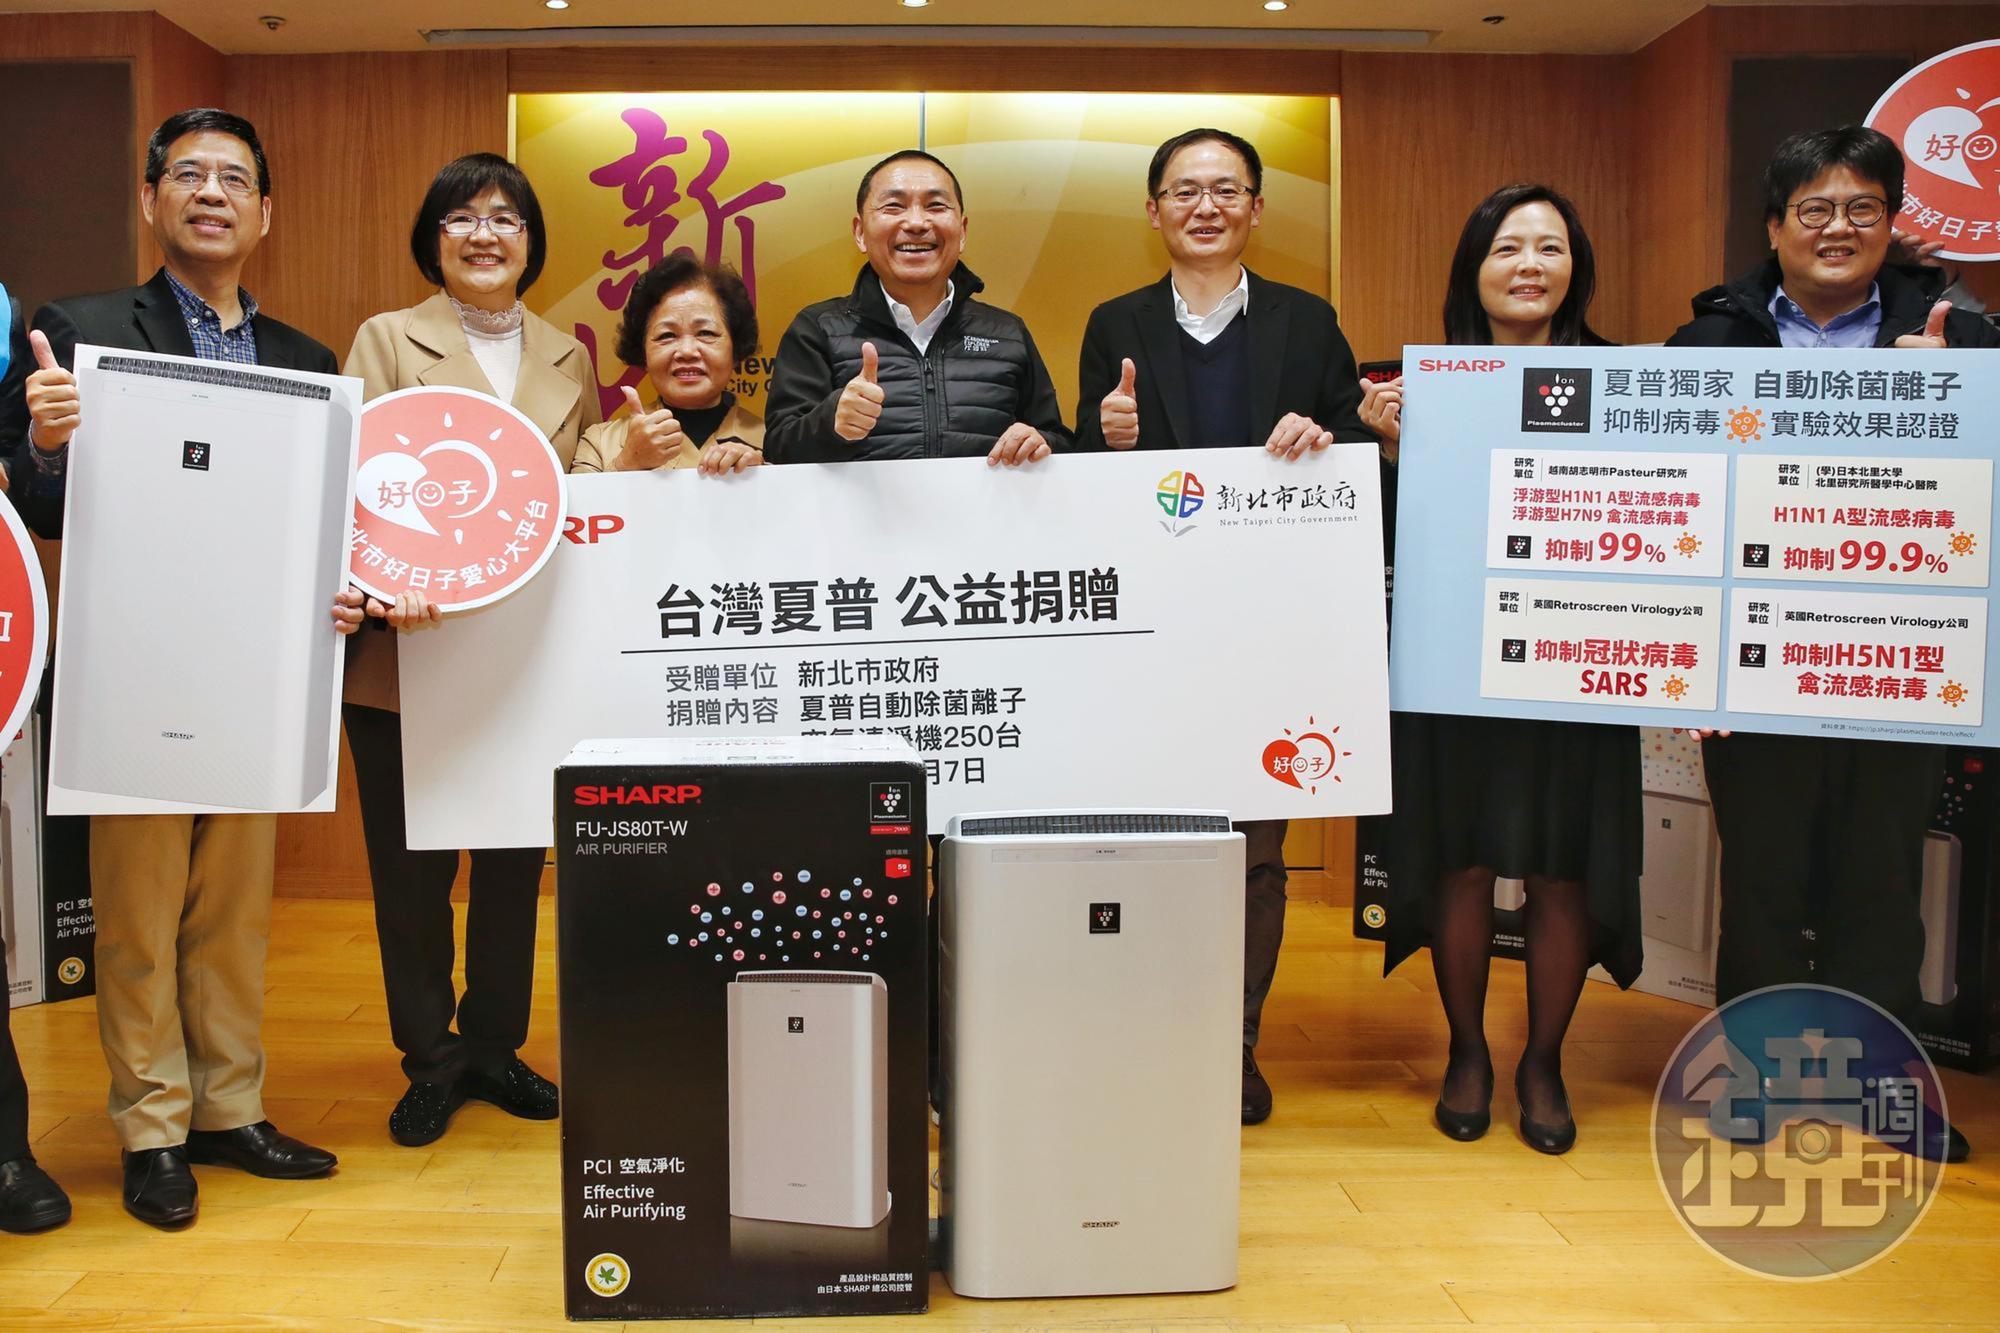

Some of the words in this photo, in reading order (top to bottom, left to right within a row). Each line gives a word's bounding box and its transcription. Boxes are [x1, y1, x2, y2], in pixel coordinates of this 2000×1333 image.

[1900, 180, 2000, 241] 市好日子
[1419, 359, 1505, 372] SHARP
[1604, 368, 1735, 398] 夏普獨家
[1754, 369, 1962, 401] 自動除菌離子
[1527, 420, 1585, 428] Plasmacluster
[1603, 407, 1721, 435] 抑制病毒
[1771, 410, 1960, 440] 實驗效果認證
[1514, 457, 1535, 467] 研究
[1778, 464, 1800, 474] 研究
[1514, 469, 1534, 479] 單位
[1778, 475, 1800, 486] 單位
[1216, 481, 1357, 512] 新北市政府
[1244, 518, 1273, 527] Taipei
[1277, 517, 1296, 526] City
[1300, 515, 1358, 523] Government
[1607, 509, 1689, 526] 禽流感病毒
[1773, 506, 1826, 525] H1N1
[1833, 507, 1956, 530] A型流感病毒
[352, 499, 549, 590] 北市好日子愛心大平台
[656, 577, 879, 639] 台灣夏普
[895, 566, 1120, 628] 公益捐贈
[1499, 592, 1520, 602] 研究
[1499, 603, 1519, 613] 單位
[1748, 602, 1770, 613] 研究
[1748, 614, 1769, 625] 單位
[1534, 638, 1698, 670] 抑制冠狀病毒
[1782, 642, 1945, 674] 抑制H5N1型
[666, 661, 779, 693] 受贈單位
[799, 656, 940, 688] 新北市政府
[1580, 669, 1648, 698] SARS
[1797, 671, 1928, 701] 禽流感病毒
[666, 697, 779, 727] 捐贈內容
[800, 687, 1026, 723] 夏普自動除菌離子
[574, 785, 702, 806] SHARP
[576, 820, 688, 837] FU-JS80T-W
[576, 843, 599, 855] AIR
[603, 842, 668, 855] PURIFIER
[1363, 878, 1375, 887] Air
[56, 901, 74, 912] PCI
[56, 914, 95, 927] Effectiv
[56, 929, 72, 939] Air
[583, 1159, 612, 1175] PCI
[620, 1157, 685, 1174] 空氣淨化
[584, 1184, 655, 1199] Effective
[583, 1203, 607, 1218] Air
[611, 1202, 686, 1220] Purifying
[843, 1284, 870, 1293] SHARP
